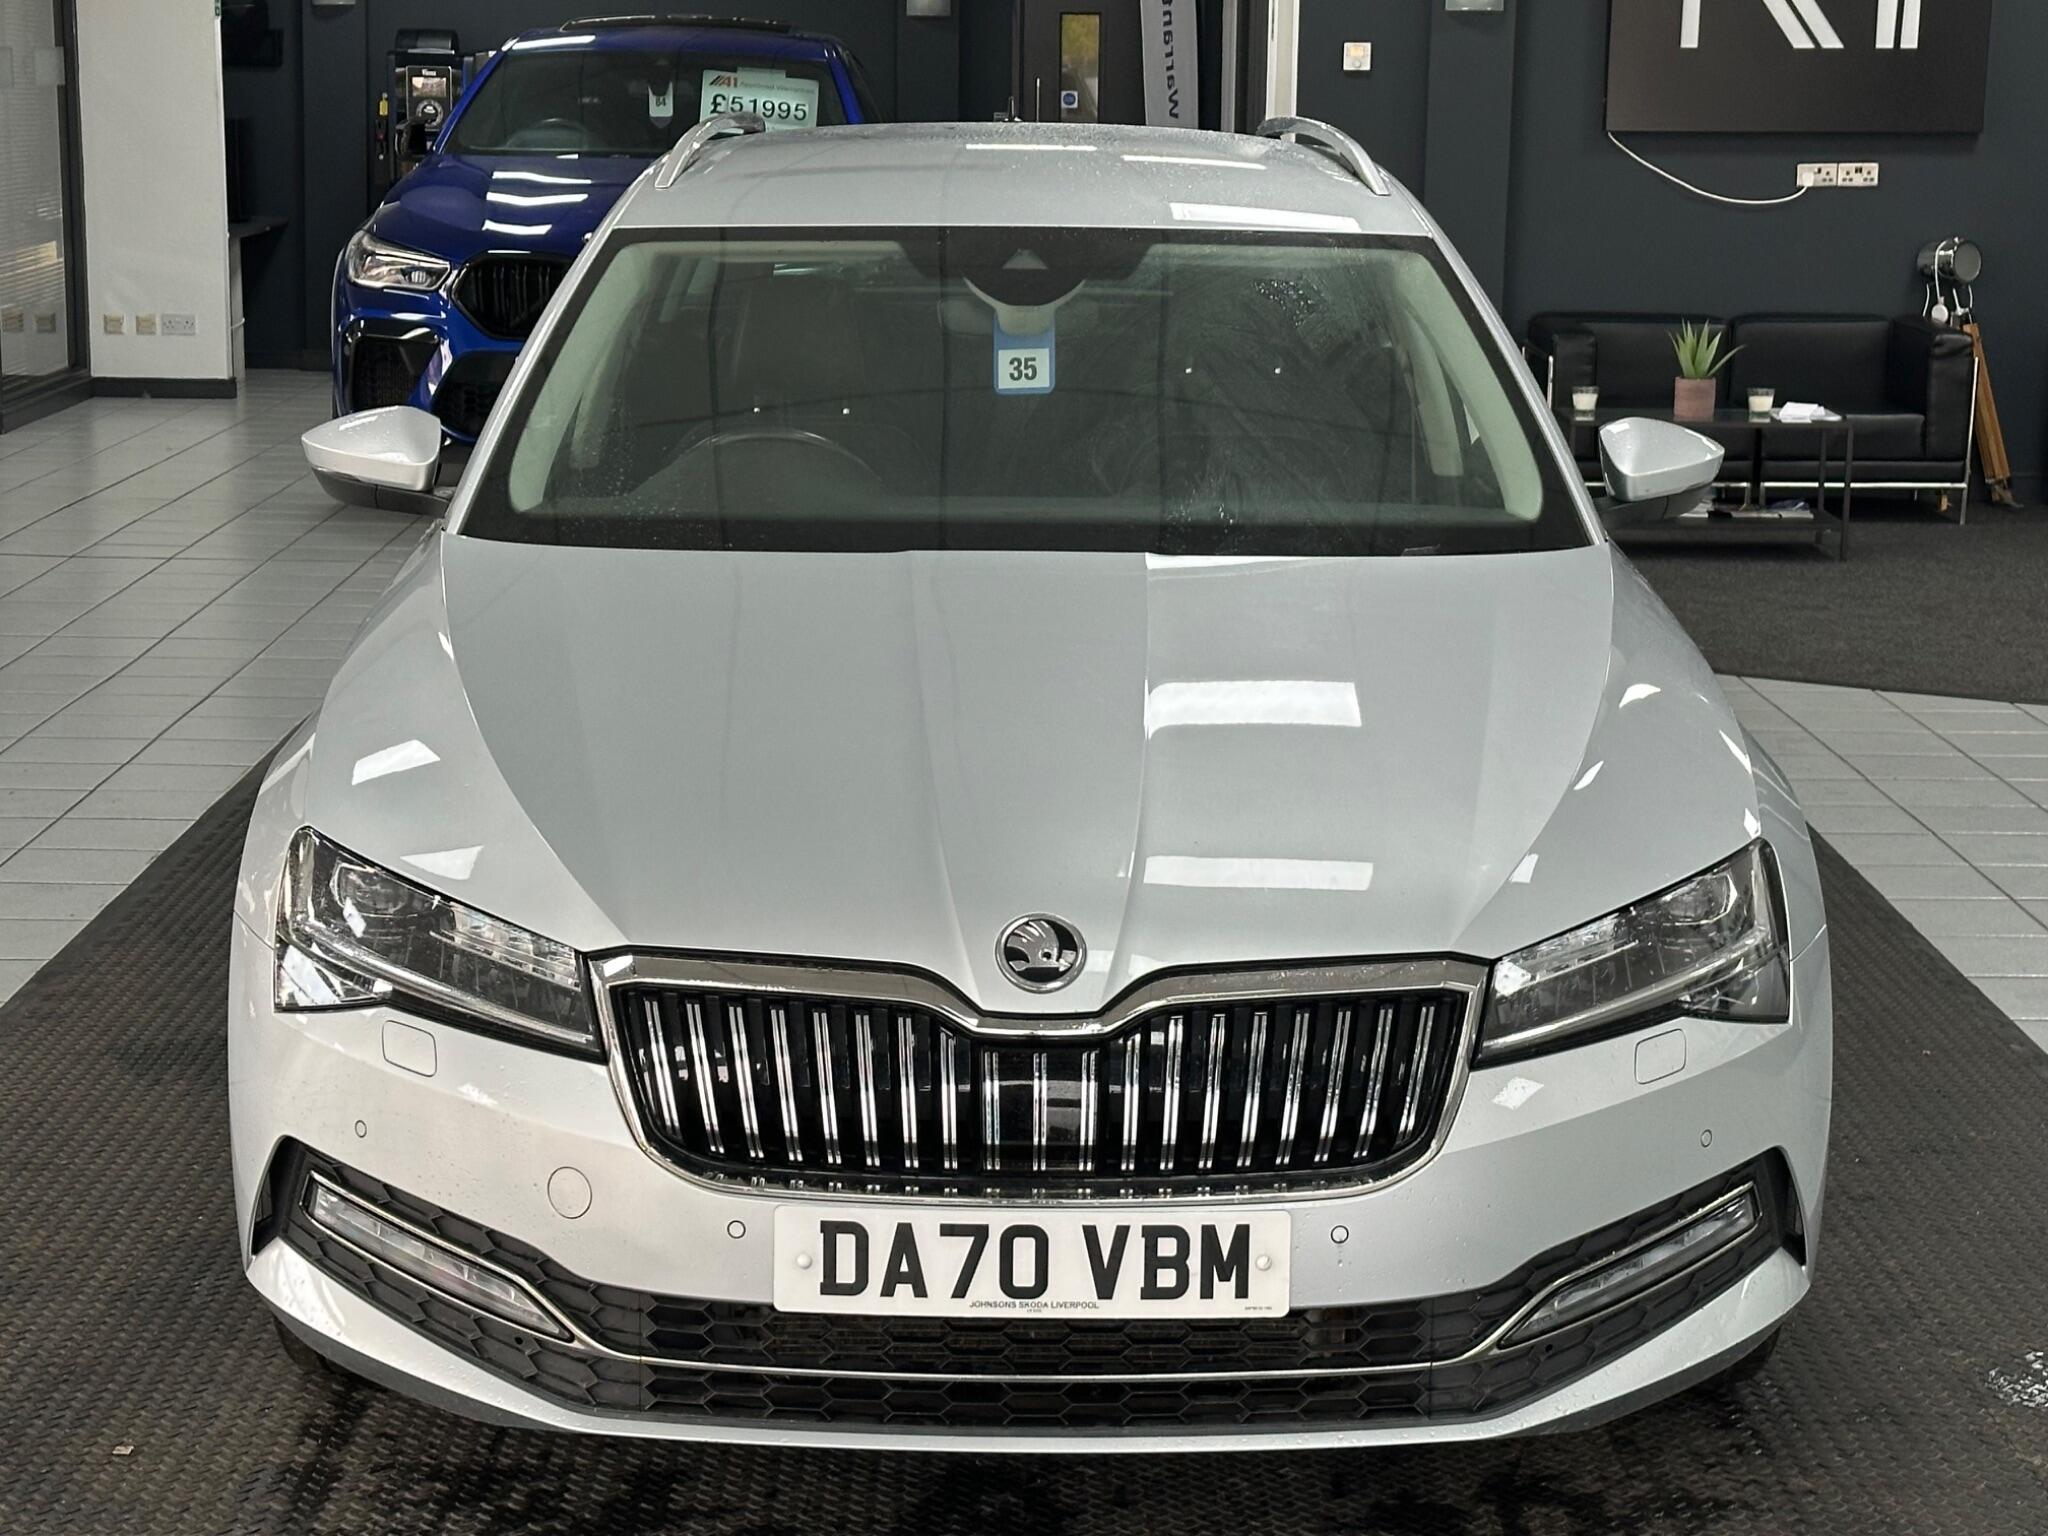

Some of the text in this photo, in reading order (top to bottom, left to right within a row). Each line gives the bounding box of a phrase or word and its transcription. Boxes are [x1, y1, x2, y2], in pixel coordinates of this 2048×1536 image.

[710, 93, 807, 121] £51995
[1008, 356, 1038, 382] 35
[820, 1220, 1250, 1300] DA70 VBM
[969, 1300, 1100, 1310] JOHNSONS SKODA LIVERPOOL
